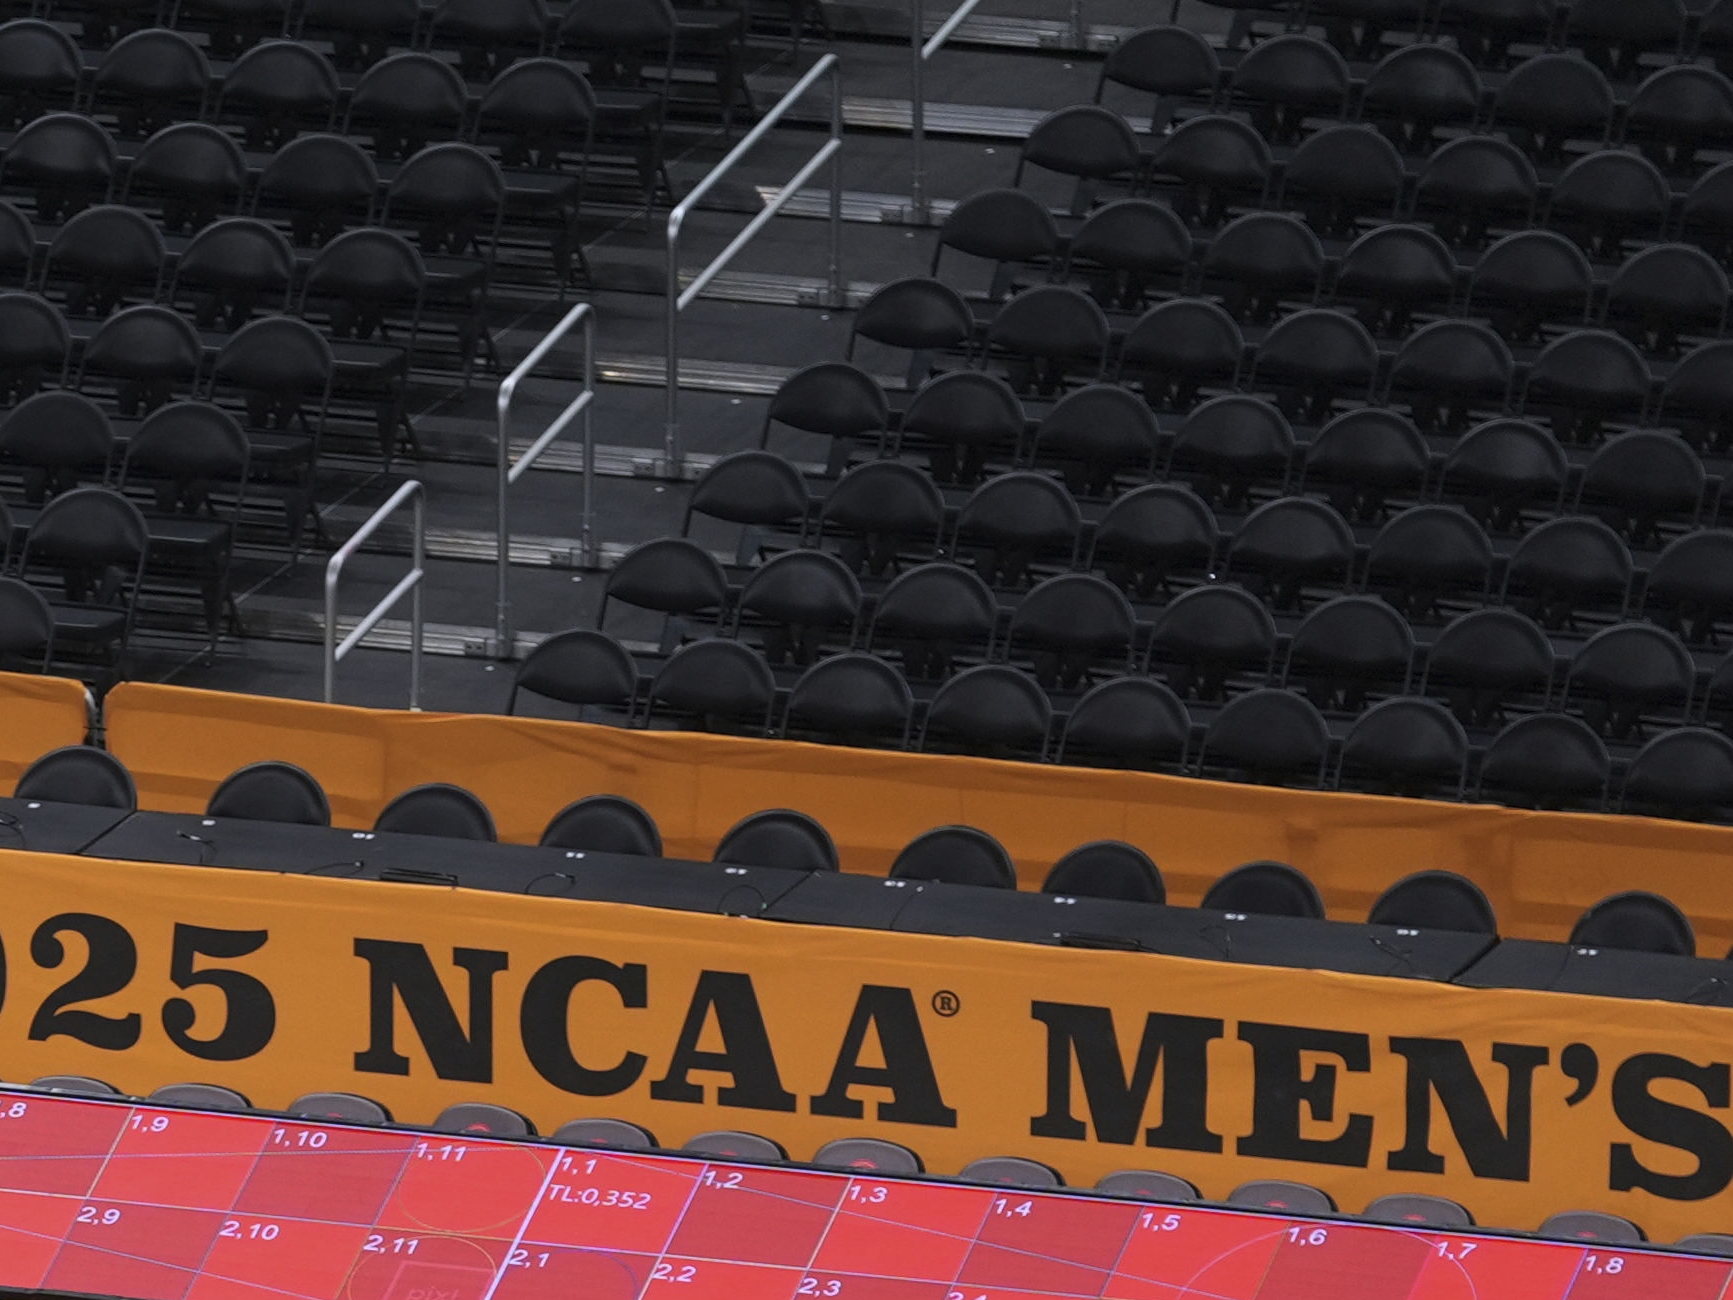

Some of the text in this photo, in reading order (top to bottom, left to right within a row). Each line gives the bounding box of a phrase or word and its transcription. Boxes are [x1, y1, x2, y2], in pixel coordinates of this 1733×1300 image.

[131, 1113, 170, 1134] 1,9
[274, 1128, 328, 1151] 1,10
[415, 1142, 467, 1164] 1,11
[560, 1156, 595, 1178] 1,1
[703, 1170, 742, 1190] 1,2
[547, 1184, 652, 1212] TL:0,352
[848, 1182, 887, 1204] 1,3
[77, 1205, 121, 1227] 2,9
[994, 1197, 1032, 1218] 1,4
[219, 1220, 280, 1242] 2,10
[1140, 1211, 1180, 1232] 1,5
[363, 1234, 421, 1256] 2,11
[1288, 1225, 1327, 1246] 1,6
[509, 1248, 550, 1270] 2,1
[1435, 1240, 1476, 1261] 1,7
[653, 1262, 697, 1284] 2,2
[1584, 1255, 1624, 1275] 1,8
[798, 1276, 842, 1298] 2,3
